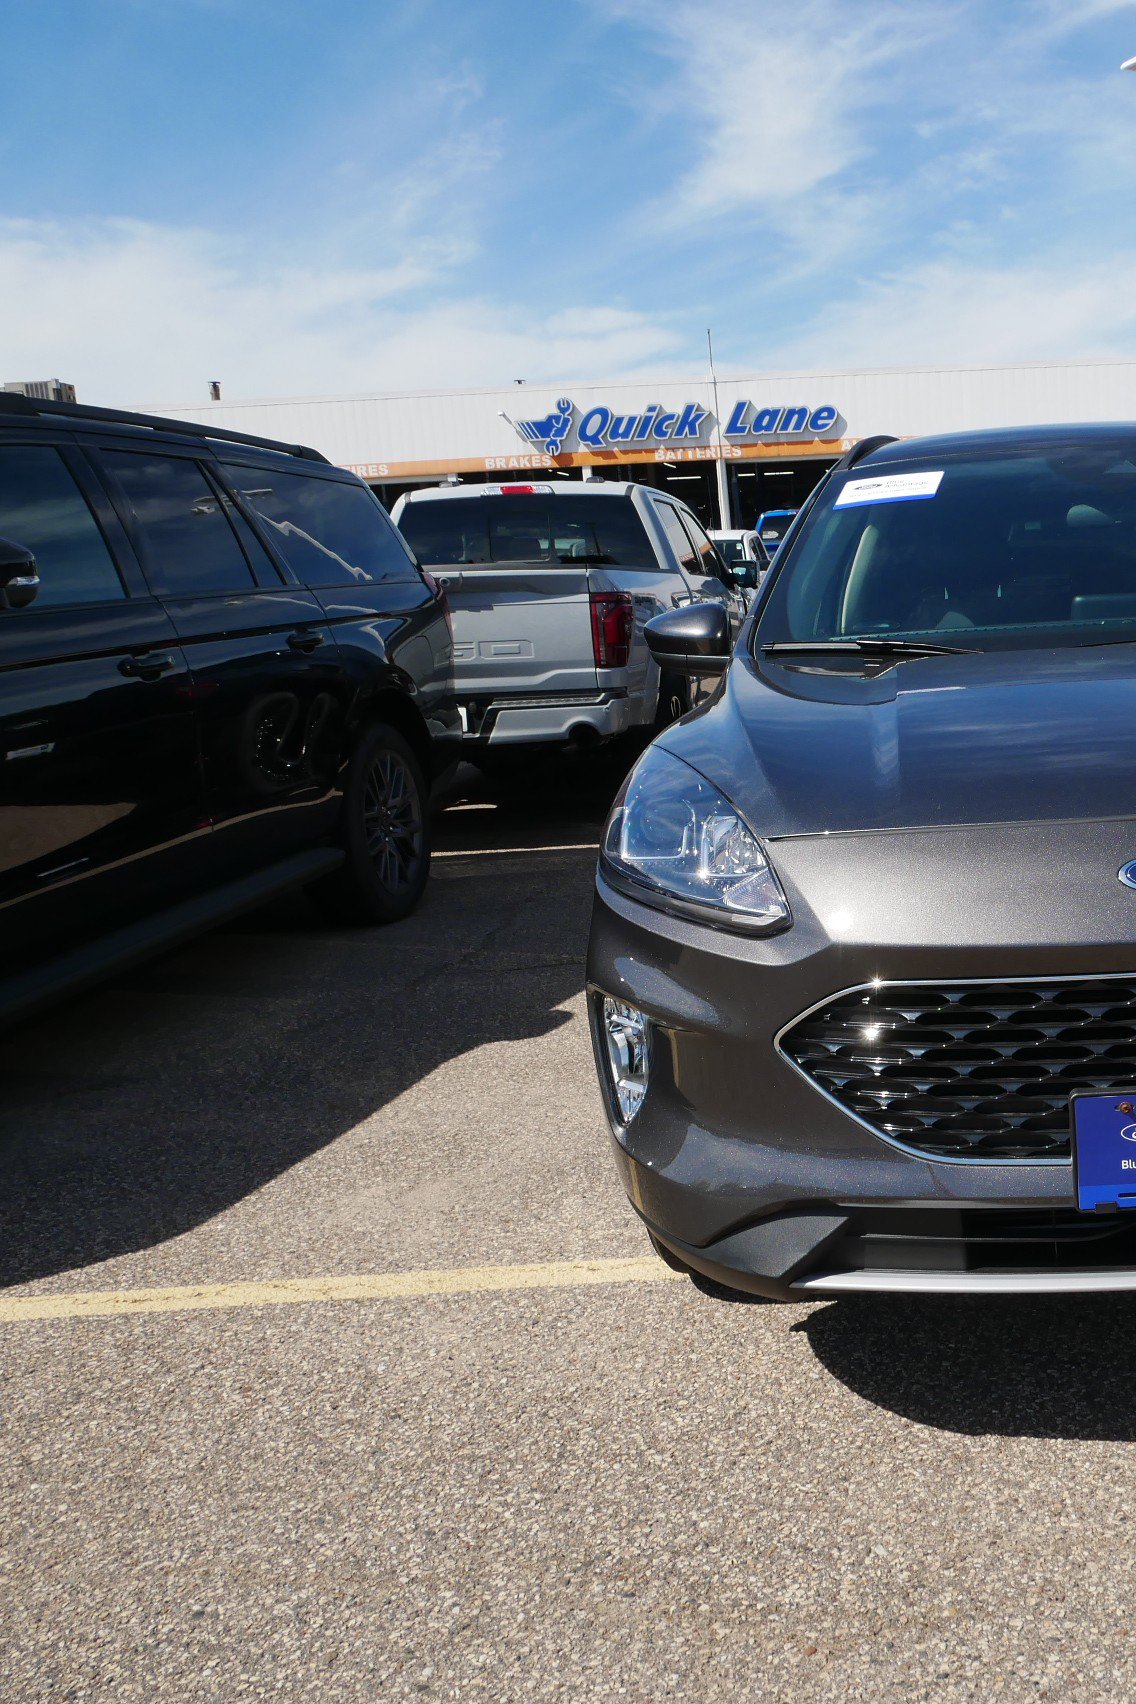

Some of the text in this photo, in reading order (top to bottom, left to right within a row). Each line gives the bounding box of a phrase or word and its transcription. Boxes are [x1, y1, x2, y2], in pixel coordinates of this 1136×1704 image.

[577, 399, 838, 447] Quick Lane
[655, 446, 742, 461] BATTERIES
[484, 454, 553, 469] BRAKES
